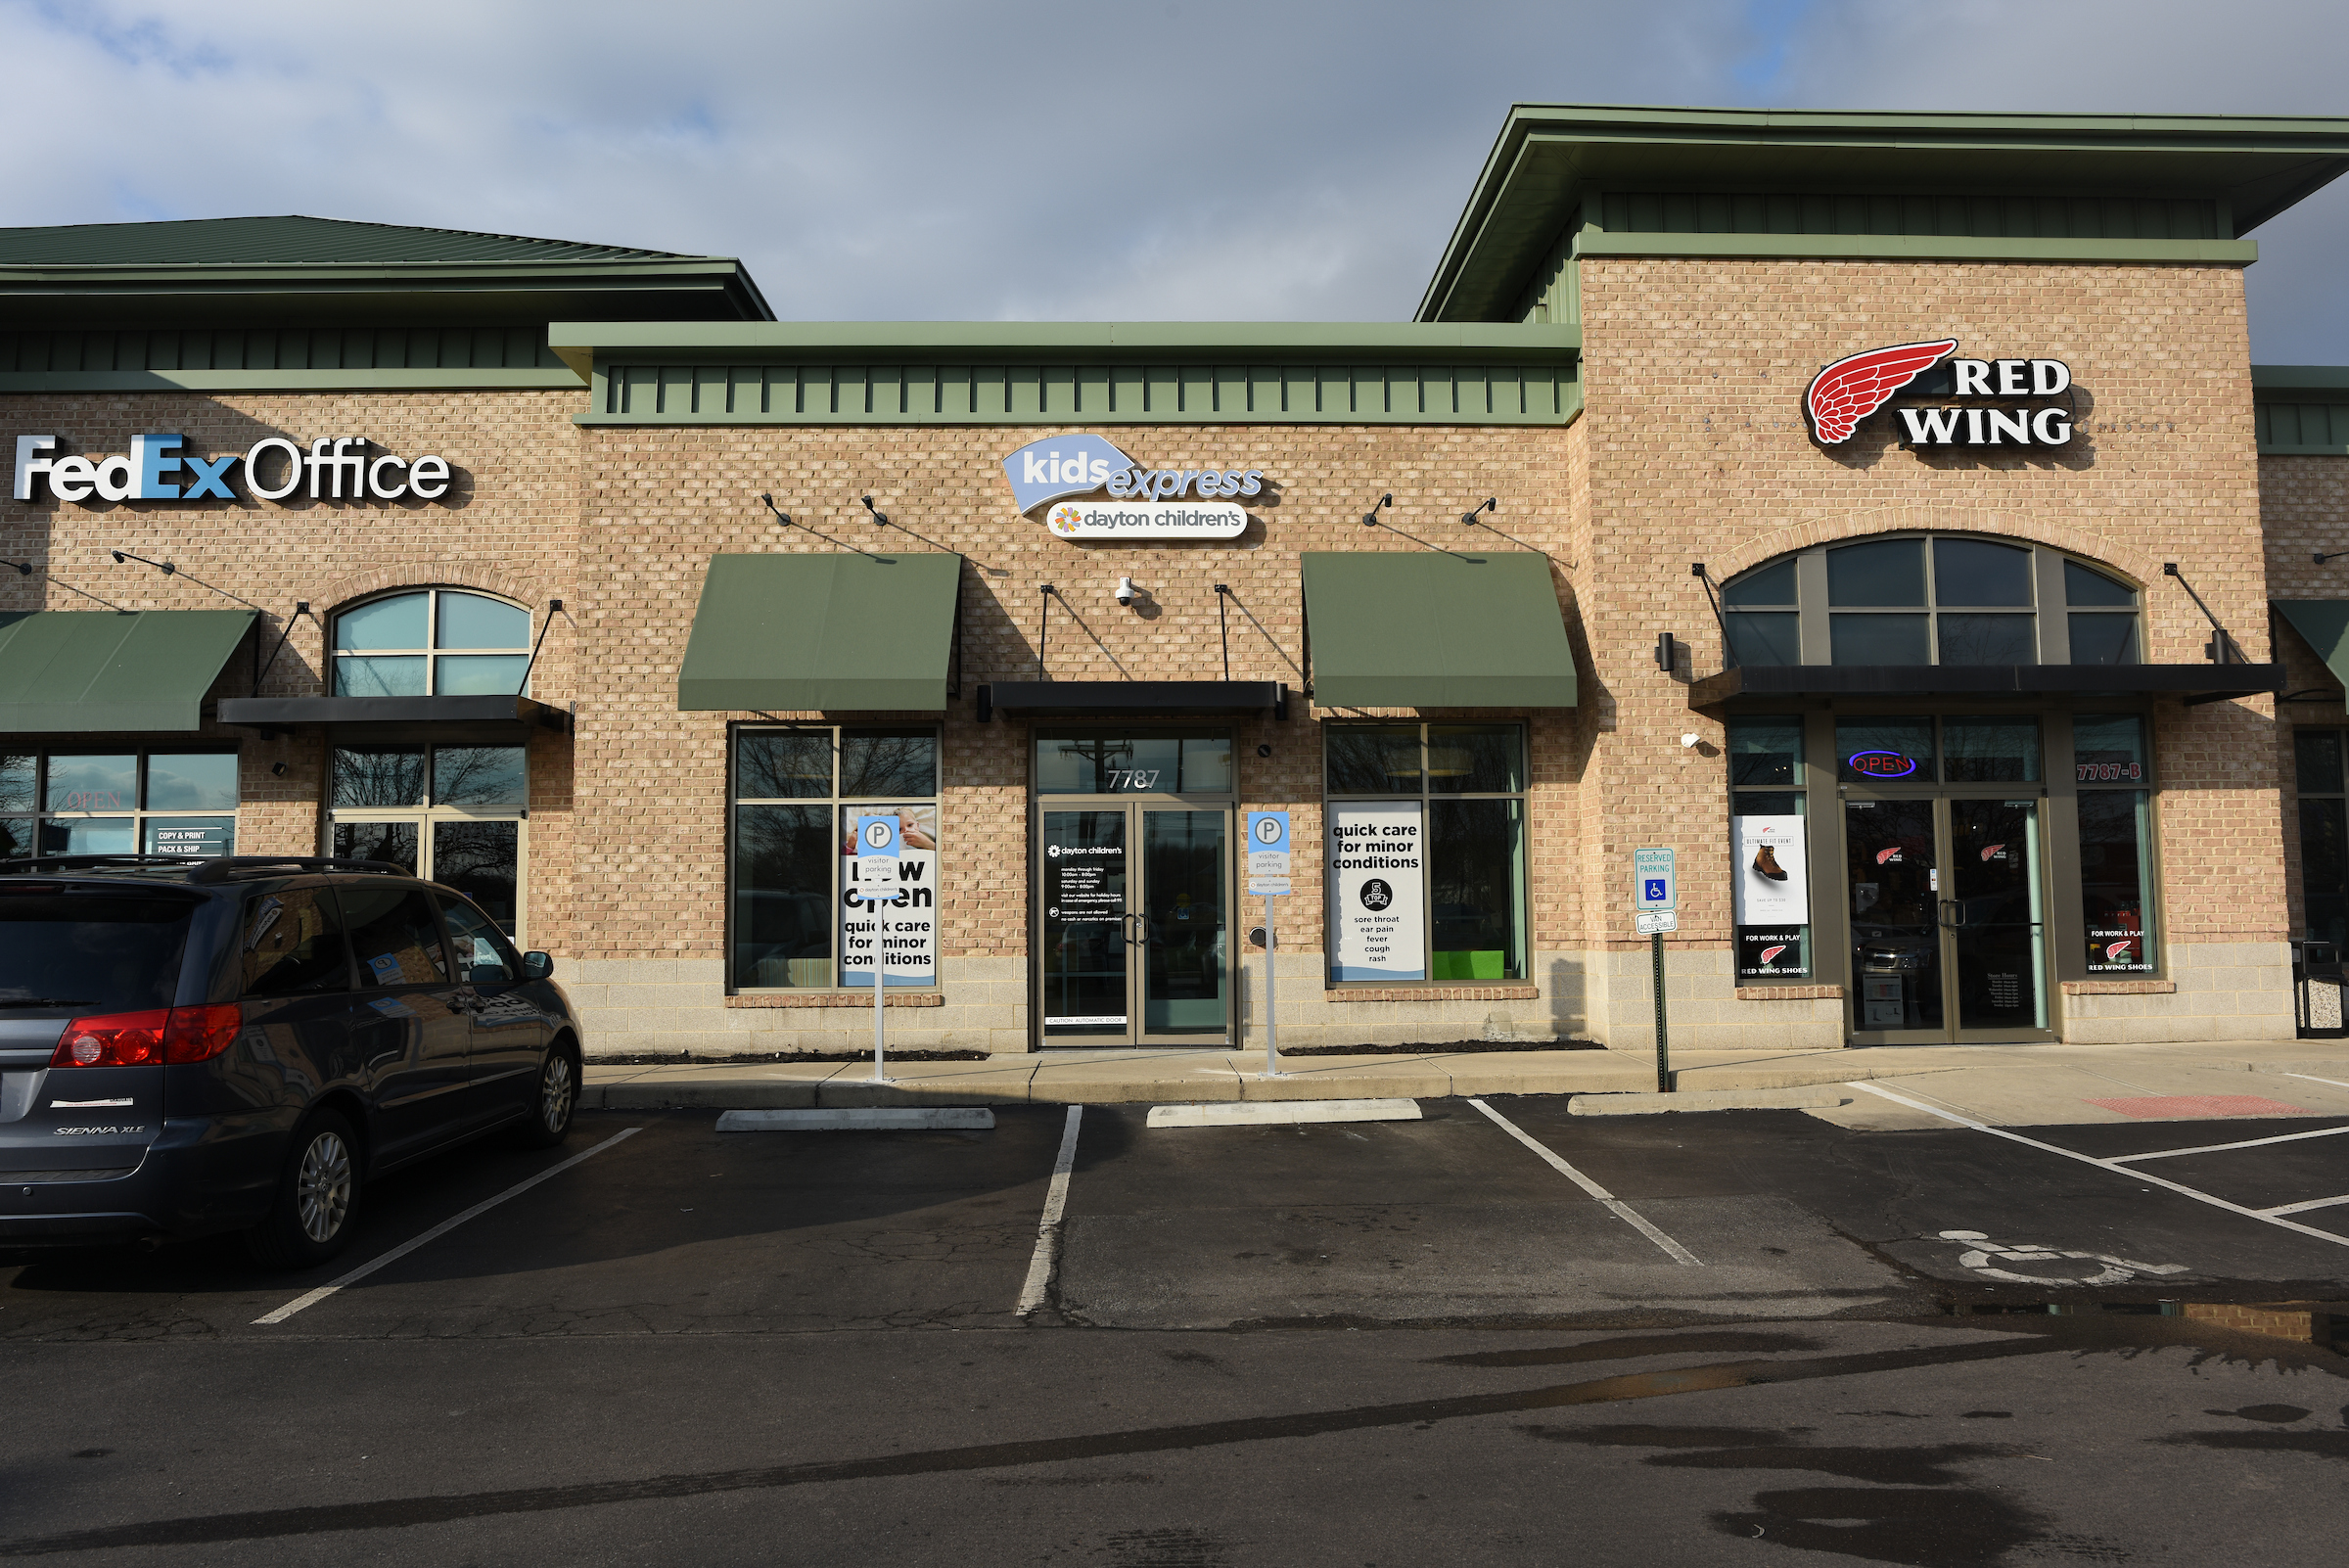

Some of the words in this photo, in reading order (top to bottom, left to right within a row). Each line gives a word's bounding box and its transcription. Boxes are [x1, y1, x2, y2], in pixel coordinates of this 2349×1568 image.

[1953, 359, 2070, 395] RED
[1897, 407, 2072, 445] WING
[13, 435, 241, 500] FedEx
[244, 437, 451, 500] Office
[1024, 451, 1109, 484] kids
[1106, 469, 1264, 502] express
[1084, 510, 1150, 529] dayton
[1154, 510, 1241, 527] children's
[1853, 756, 1911, 772] OPEN
[2077, 762, 2142, 781] 7787-B
[1108, 770, 1160, 789] 7787
[68, 791, 121, 809] OPEN
[1333, 824, 1377, 839] quick
[1382, 826, 1417, 836] care
[1061, 847, 1087, 855] dayton
[1337, 840, 1361, 853] for
[1366, 840, 1413, 853] minor
[1333, 856, 1419, 869] conditions
[1637, 854, 1671, 862] RESERVED
[865, 865, 892, 873] parking
[1256, 861, 1282, 869] parking
[1371, 883, 1381, 894] 5
[895, 922, 930, 932] care
[1640, 921, 1674, 930] ACCESSIBLE
[849, 936, 873, 948] for
[1365, 945, 1390, 953] cough
[843, 953, 931, 965] conitions
[53, 1126, 118, 1136] SIENNA
[120, 1125, 145, 1134] XLE
